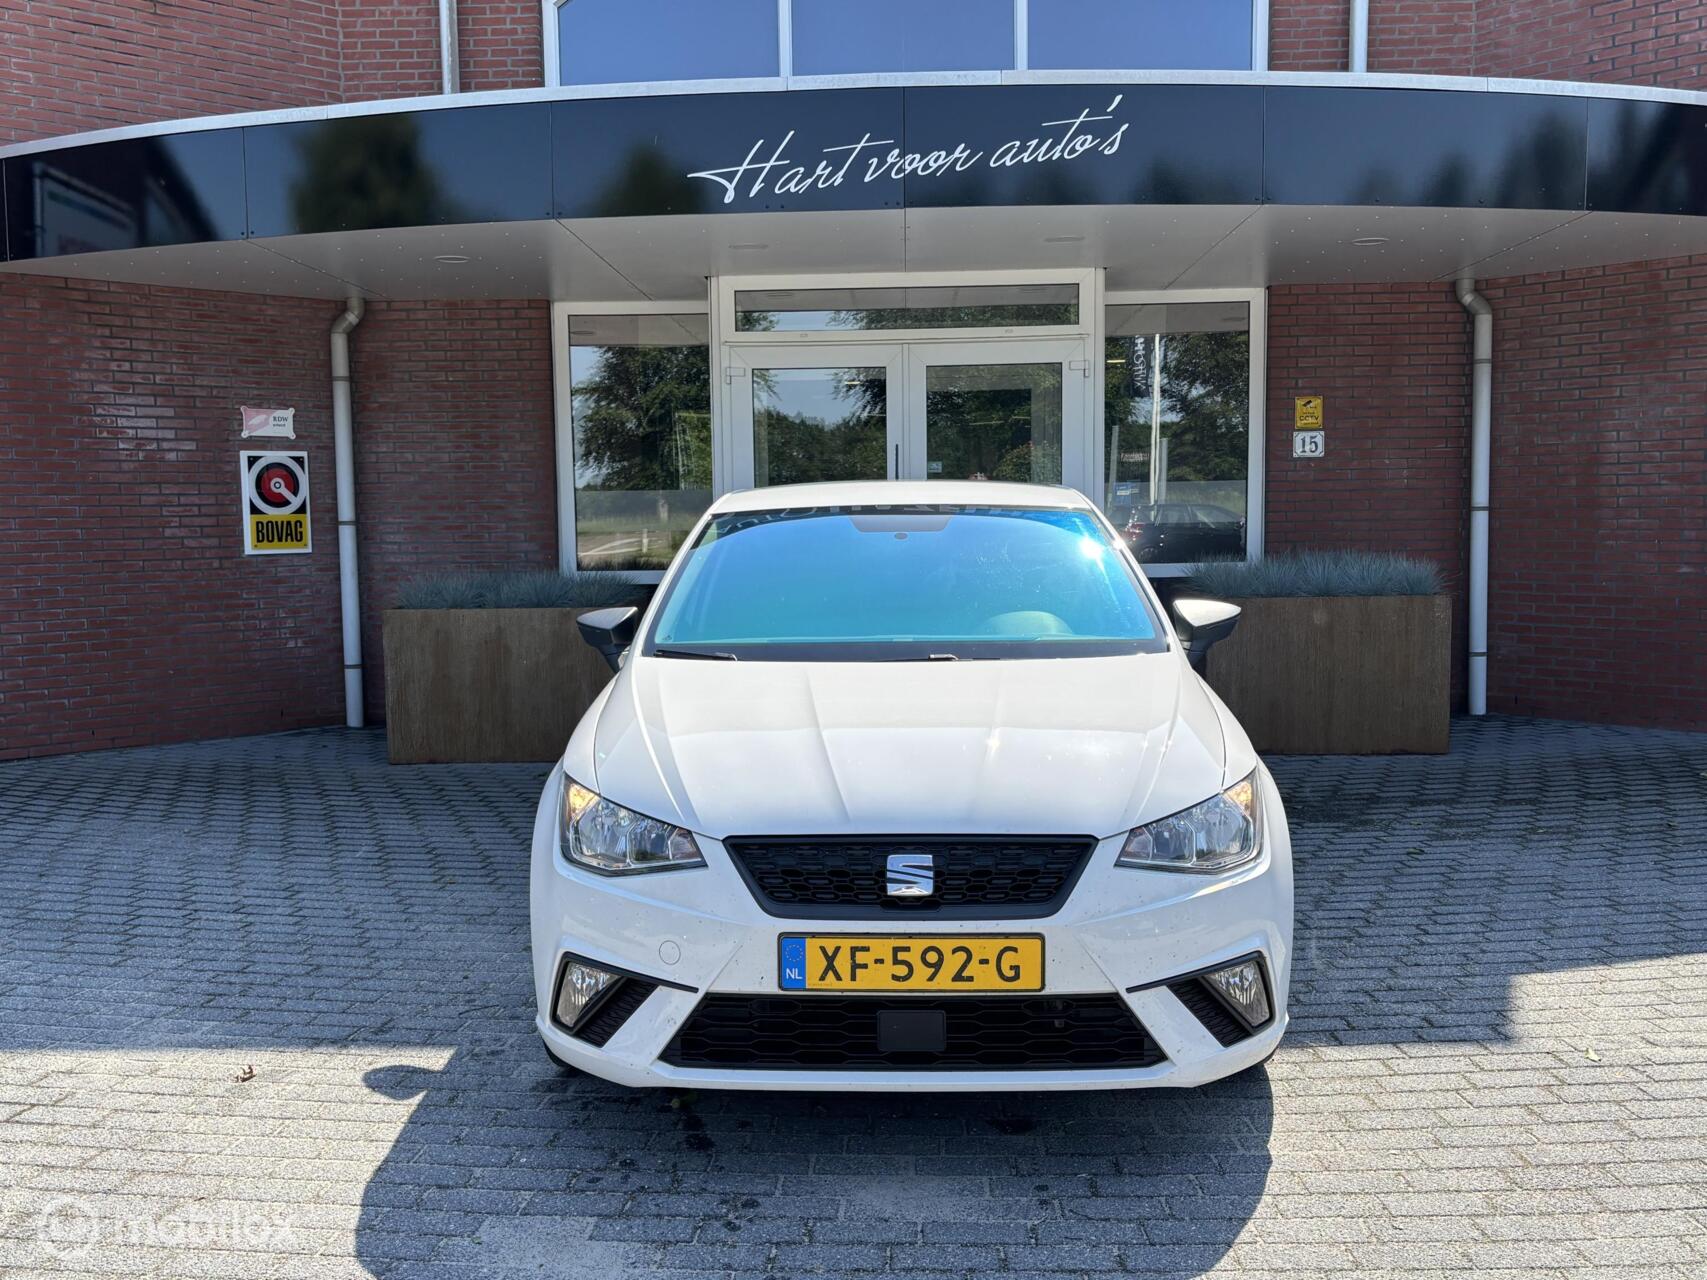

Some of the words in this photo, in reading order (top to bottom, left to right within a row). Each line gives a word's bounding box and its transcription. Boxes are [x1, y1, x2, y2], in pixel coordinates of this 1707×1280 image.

[687, 130, 894, 204] Hart
[863, 148, 983, 183] voor
[989, 94, 1130, 167] auto's
[1300, 435, 1319, 454] 15
[255, 519, 304, 544] BOVAG
[785, 967, 803, 980] NL
[818, 945, 1021, 983] XF-592-G
